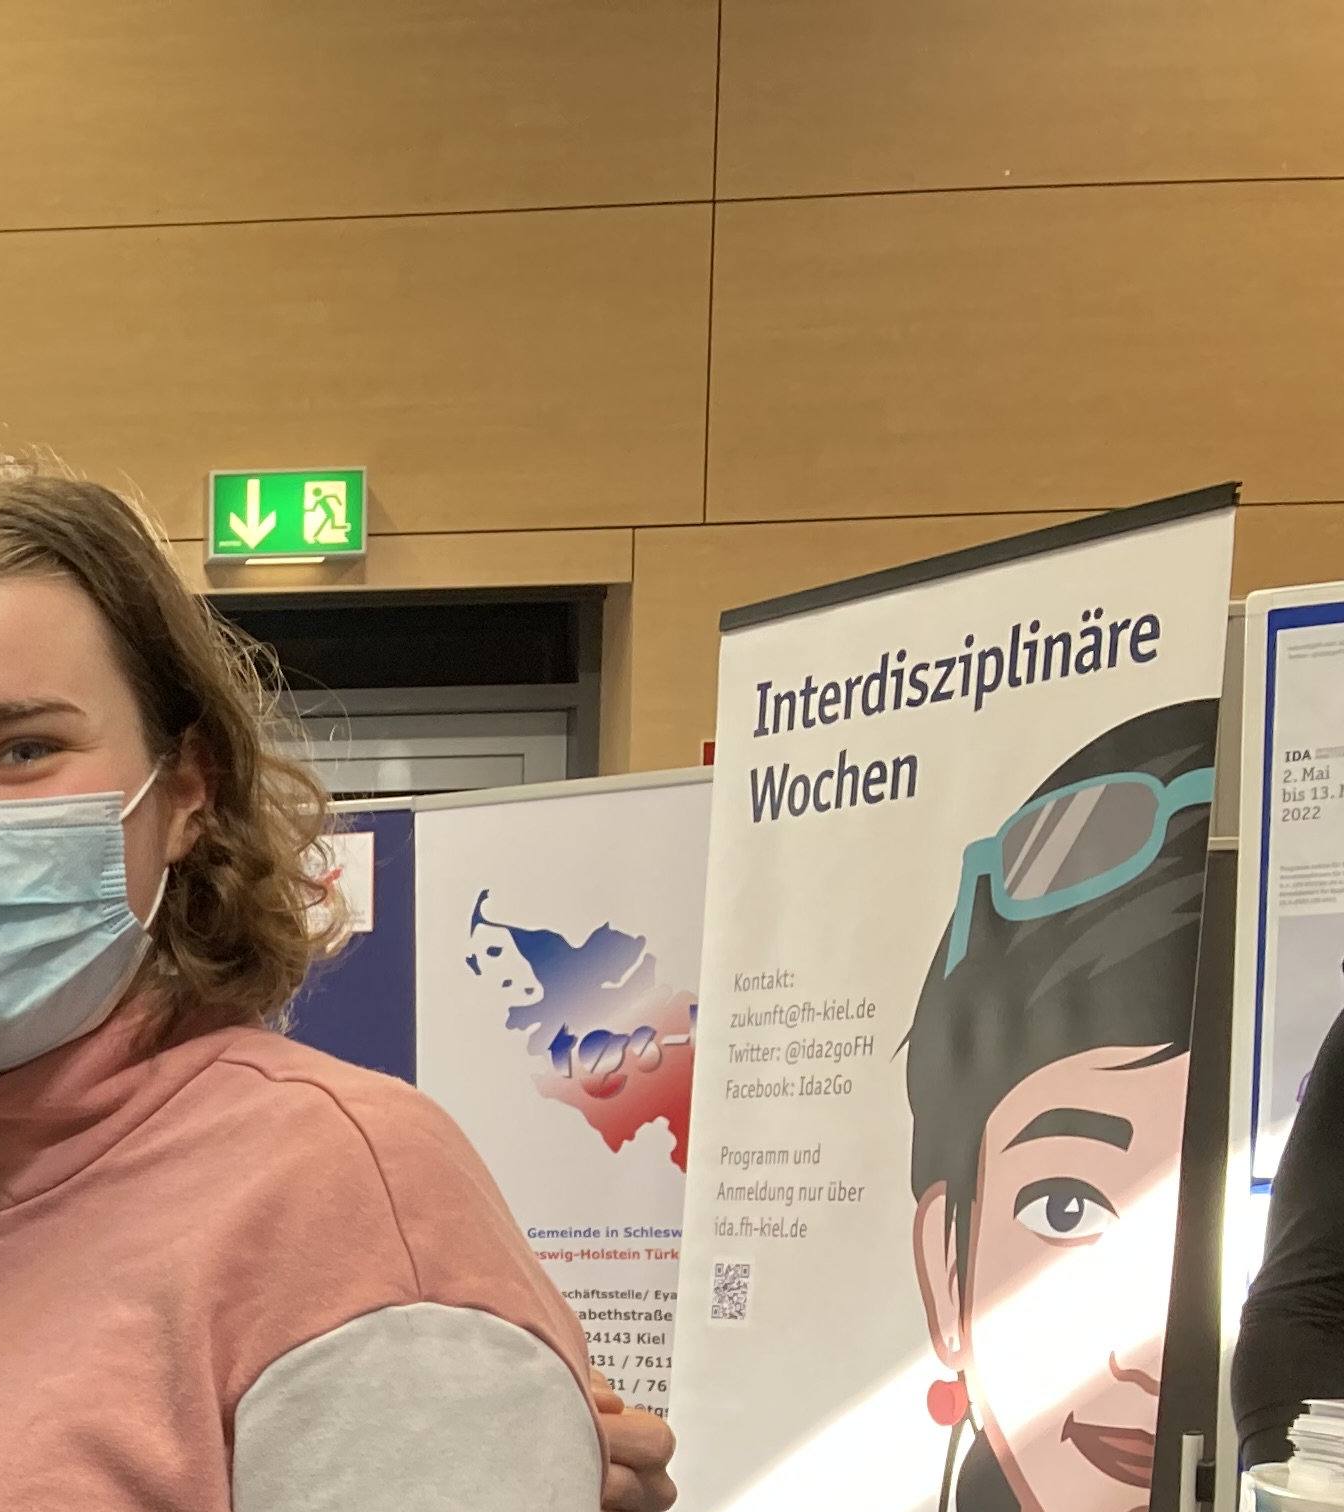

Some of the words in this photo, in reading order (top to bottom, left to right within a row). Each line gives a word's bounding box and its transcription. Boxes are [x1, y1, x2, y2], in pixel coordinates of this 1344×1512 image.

[753, 607, 1161, 738] Interdisziplinäre
[1285, 749, 1311, 762] IDA
[1283, 769, 1297, 783] 2.
[1301, 765, 1330, 782] Mai
[750, 749, 918, 823] Wochen
[1282, 787, 1305, 803] bis
[1311, 785, 1335, 800] 13.
[1281, 806, 1321, 822] 2022
[734, 968, 795, 992] Kontakt:
[730, 997, 876, 1028] zukunft@fh-kiel.de
[728, 1042, 781, 1063] Twitter:
[785, 1035, 874, 1065] @ida2goFH
[725, 1076, 795, 1099] Facebook:
[799, 1074, 853, 1096] Ida2Go
[720, 1145, 789, 1170] Programm
[793, 1143, 822, 1165] und
[716, 1180, 794, 1207] Anmeldung
[798, 1186, 824, 1202] nur
[827, 1180, 865, 1202] über
[527, 1227, 601, 1239] Gemeinde
[606, 1227, 618, 1238] in
[624, 1226, 682, 1239] Schlesw
[714, 1216, 808, 1238] ida.fh-kiel.de
[645, 1248, 679, 1261] Türk
[576, 1308, 673, 1321] abethstraße
[585, 1332, 631, 1344] 24143
[637, 1333, 665, 1345] Kiel
[647, 1380, 667, 1392] 76
